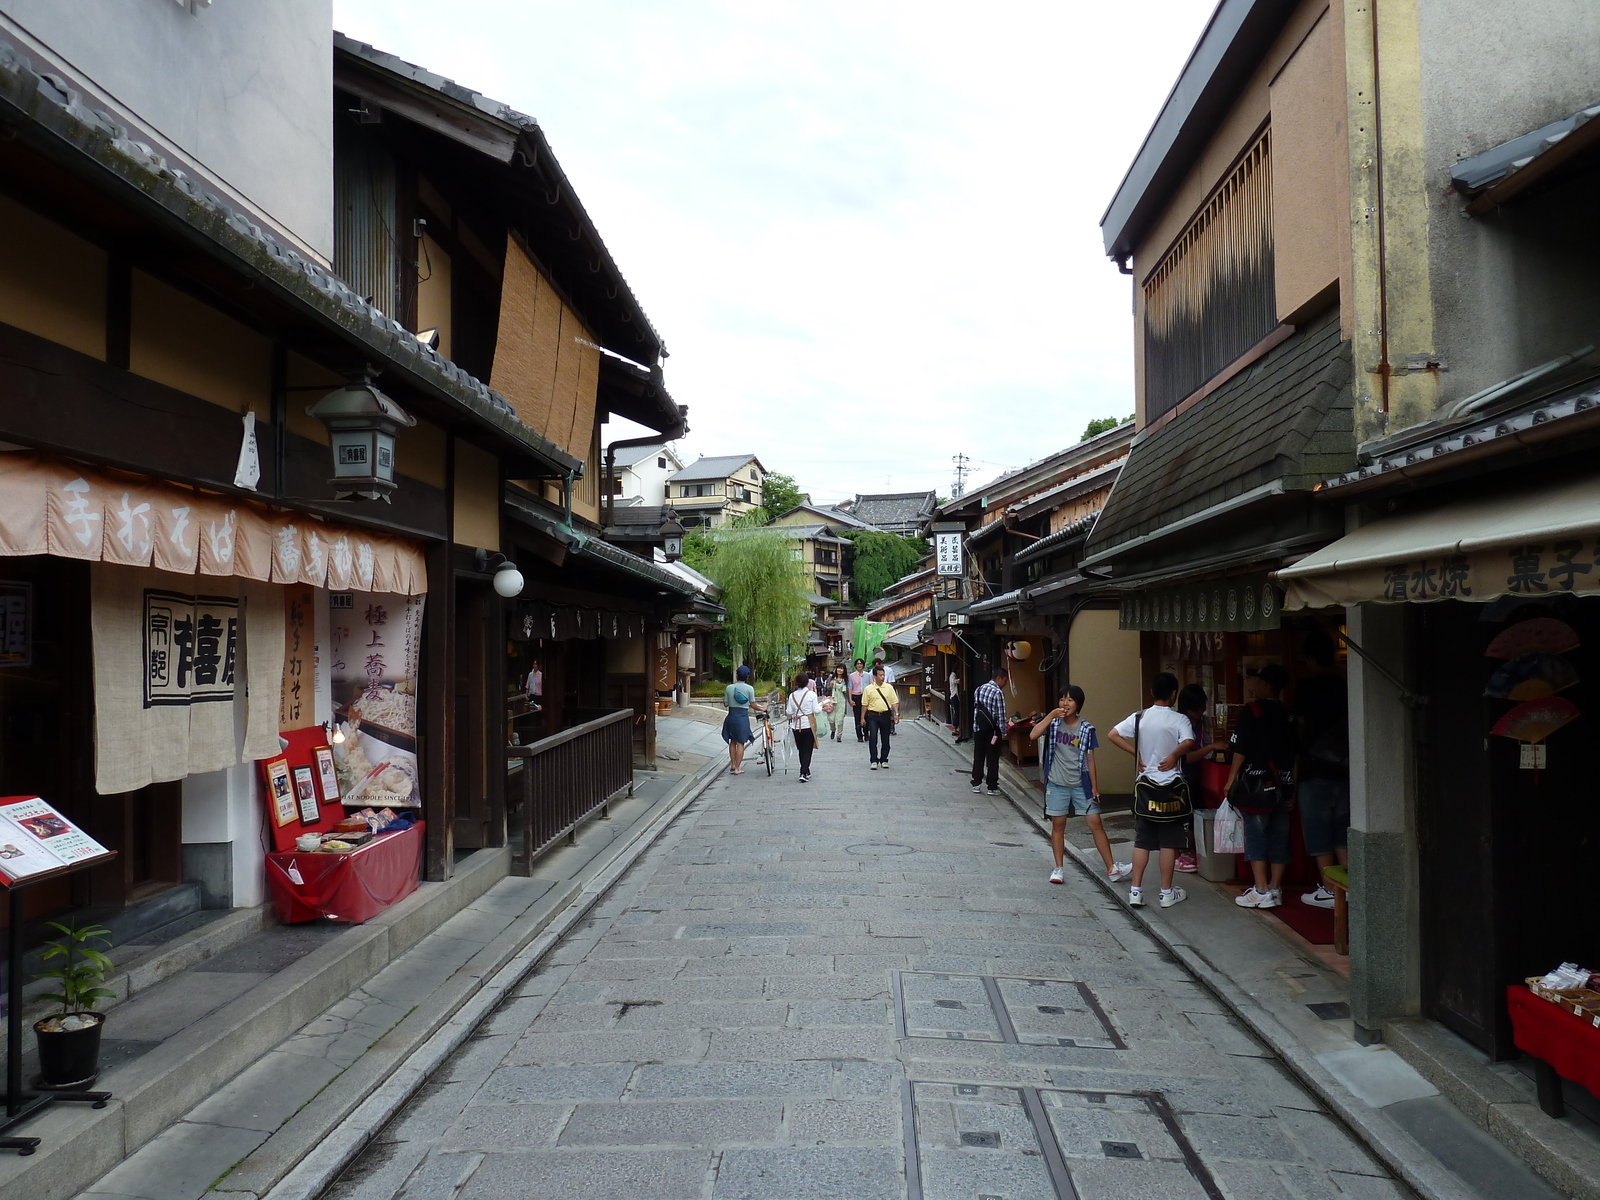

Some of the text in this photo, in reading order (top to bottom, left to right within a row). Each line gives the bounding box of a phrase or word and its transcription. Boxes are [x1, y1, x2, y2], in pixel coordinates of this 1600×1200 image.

[62, 477, 236, 563] 手打そば
[1383, 538, 1600, 600] 清水焼 菓子
[151, 612, 169, 681] 京都
[364, 603, 388, 702] 極上蕎麦
[1148, 799, 1181, 813] PUMA
